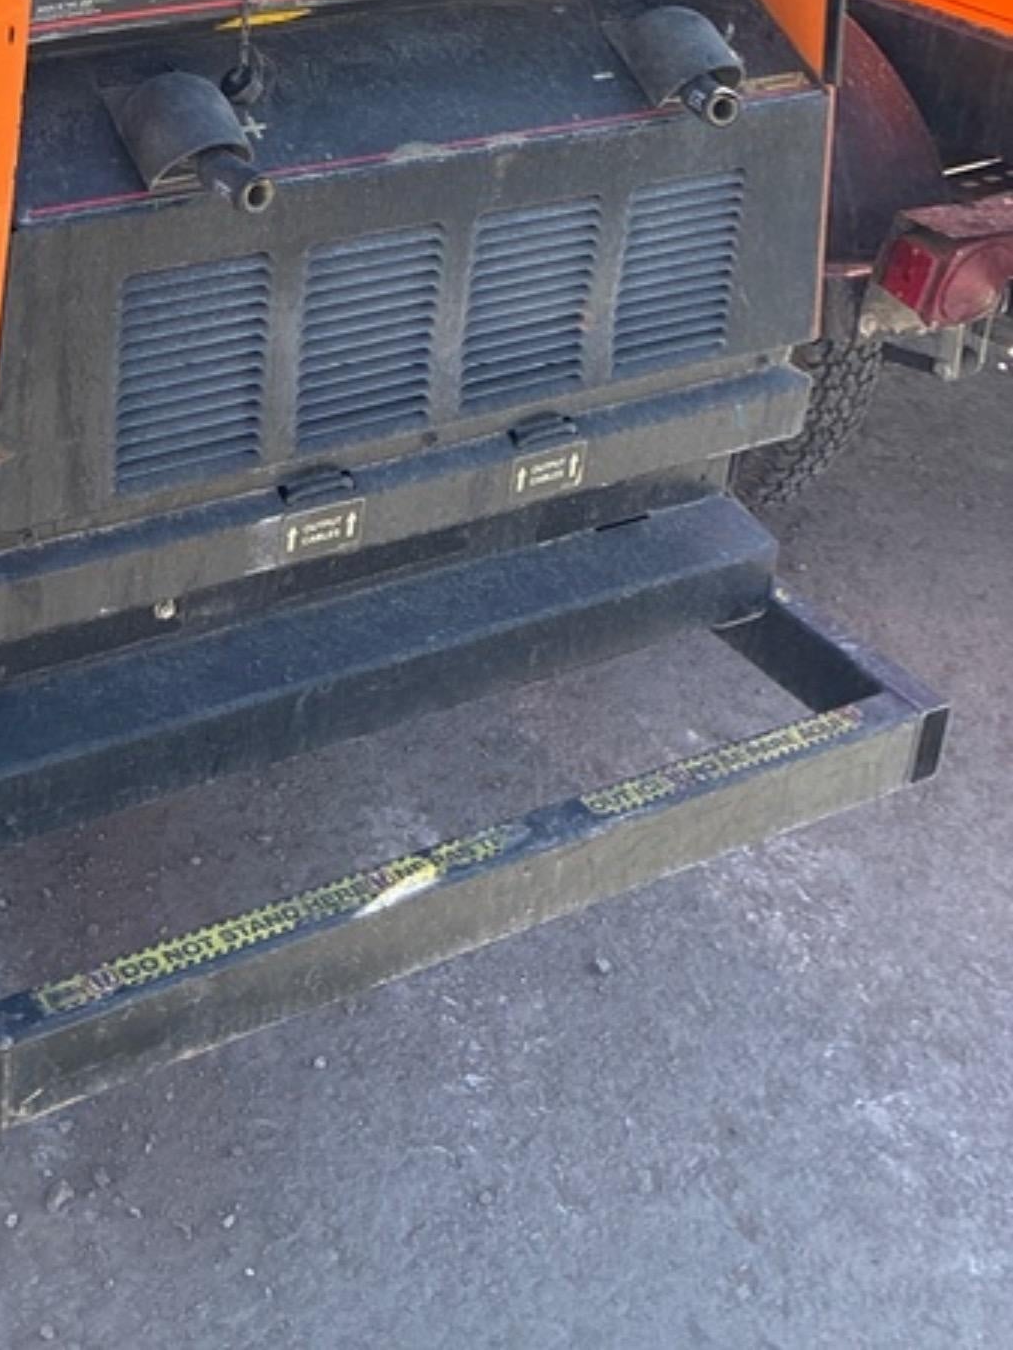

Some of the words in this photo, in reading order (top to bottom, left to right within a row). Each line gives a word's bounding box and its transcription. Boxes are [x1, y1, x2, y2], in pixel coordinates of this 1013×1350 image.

[119, 955, 160, 978] DO
[164, 935, 214, 964] NOT
[218, 905, 300, 942] STAND
